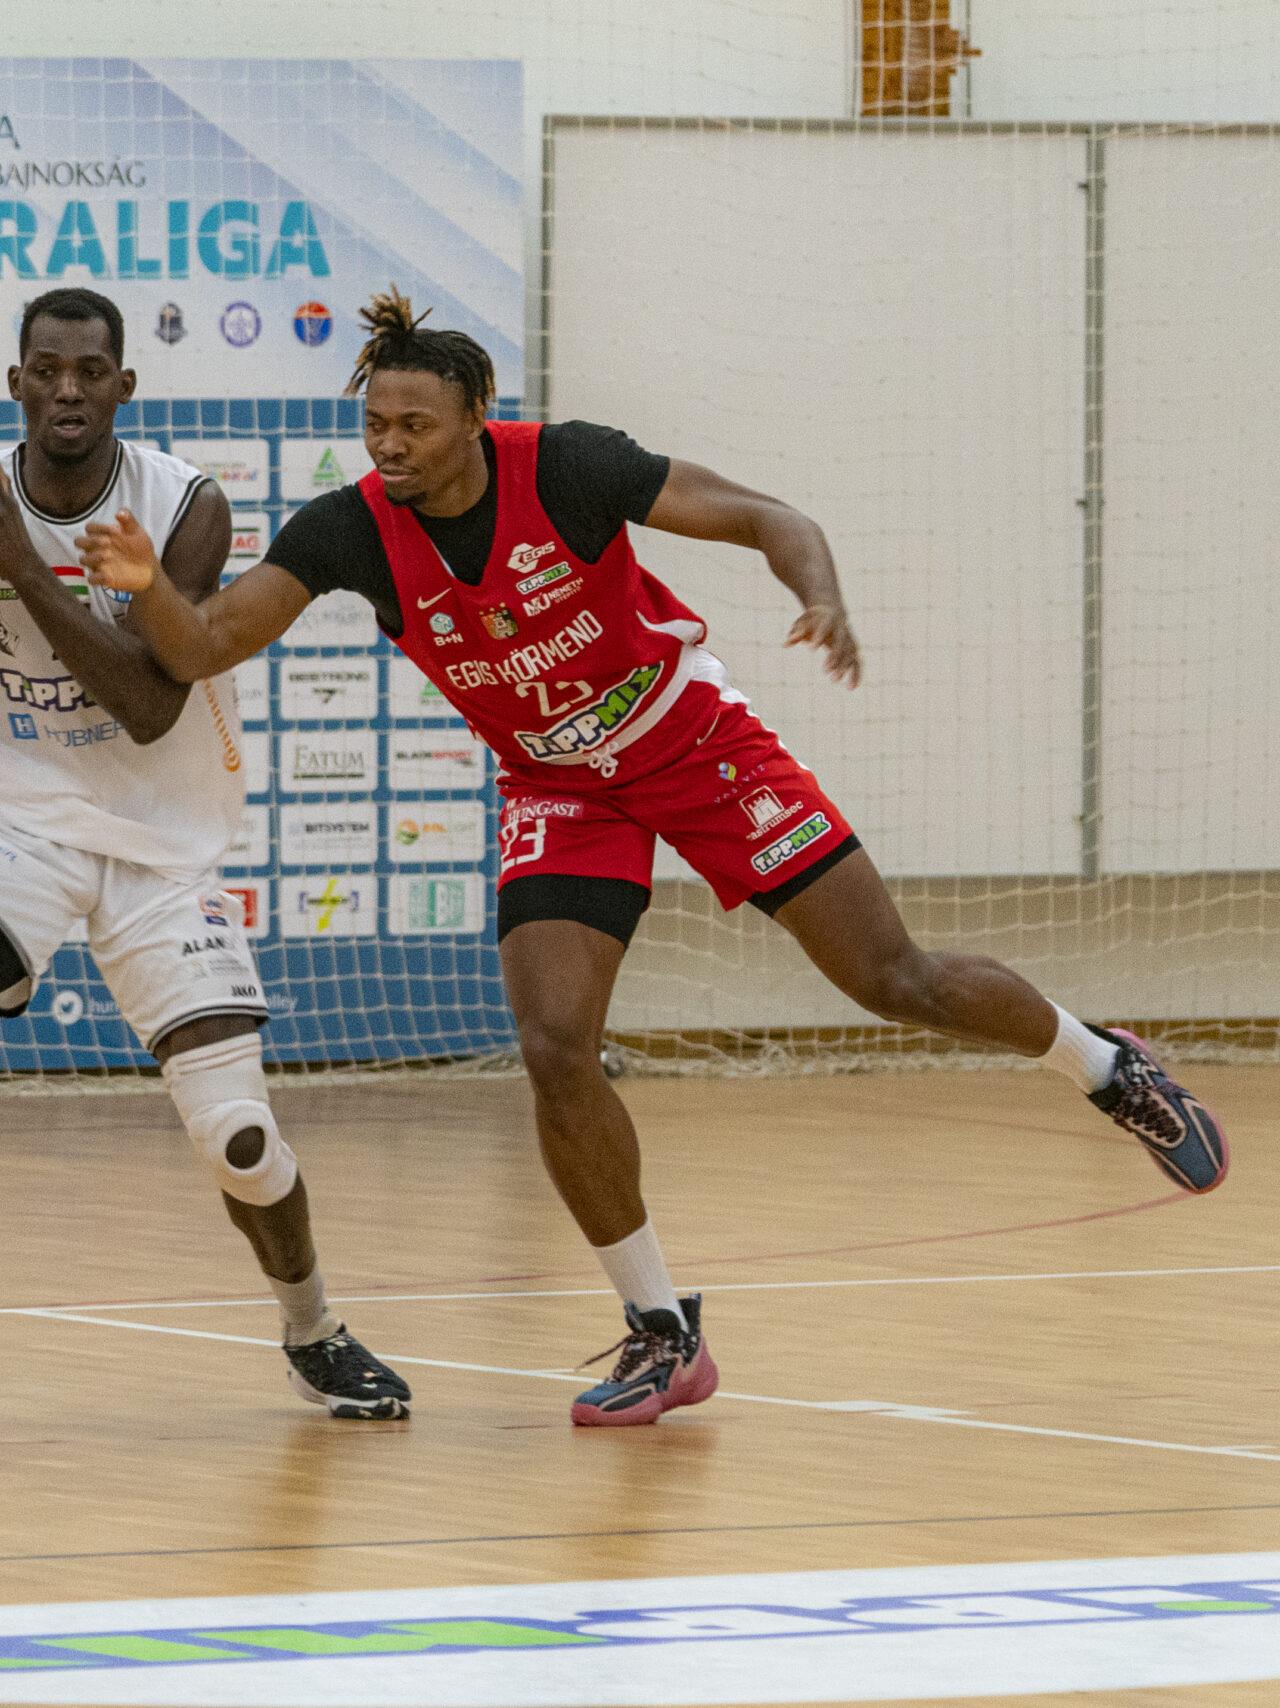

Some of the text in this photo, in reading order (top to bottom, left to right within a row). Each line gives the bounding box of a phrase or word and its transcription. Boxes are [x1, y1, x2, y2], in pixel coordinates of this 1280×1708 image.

[445, 609, 604, 690] EGIS KÖRMEND
[294, 744, 365, 771] FATUM
